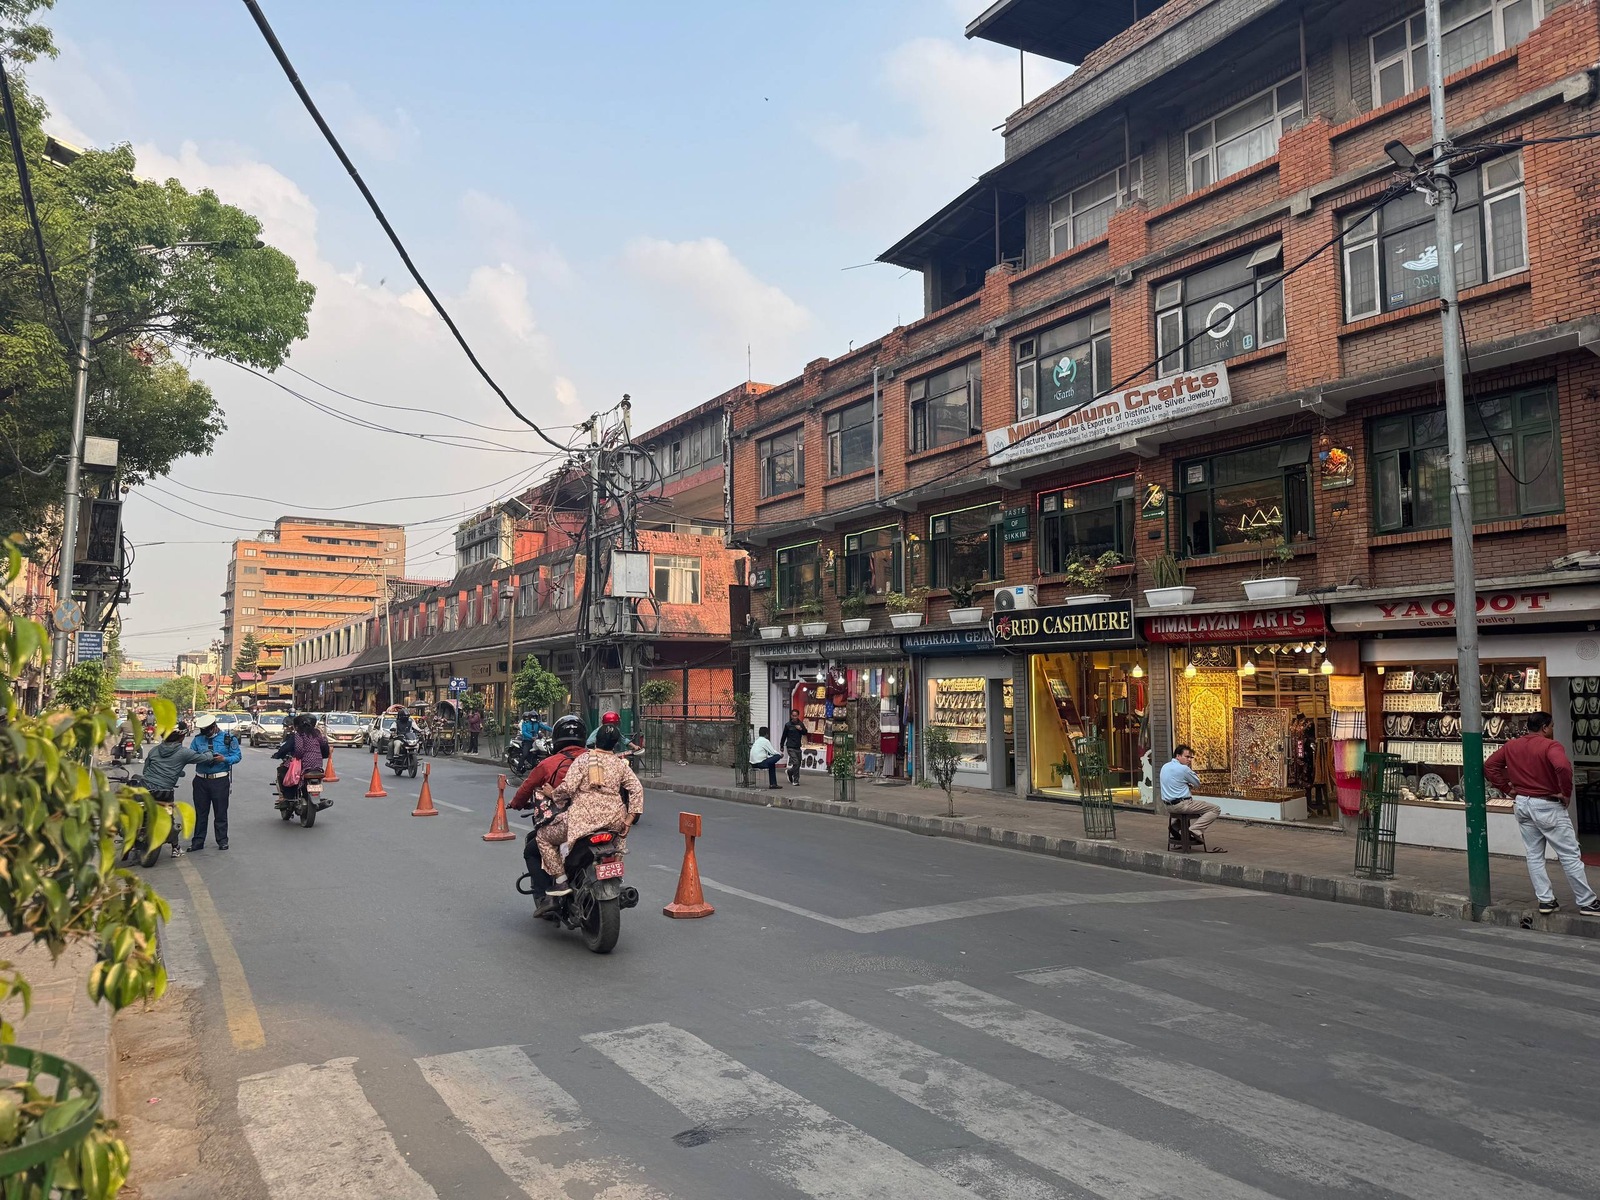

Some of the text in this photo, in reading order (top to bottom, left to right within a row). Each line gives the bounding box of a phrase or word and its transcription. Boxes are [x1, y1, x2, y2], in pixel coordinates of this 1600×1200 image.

[1007, 372, 1219, 444] Millennium Crafts
[1047, 426, 1079, 441] Wholesaler
[1080, 423, 1087, 432] &
[1087, 416, 1113, 431] Exporter
[1115, 413, 1122, 422] of
[1124, 403, 1162, 420] Distinctive
[1164, 396, 1185, 409] Silver
[1188, 388, 1216, 402] Jewelry
[1005, 507, 1026, 516] TASTE
[1005, 531, 1027, 541] SIKKIM
[1011, 611, 1130, 636] RED CASHMERE
[1152, 609, 1306, 633] HIMALAYAN ARTS
[905, 633, 961, 646] MAHARAJA
[1195, 631, 1205, 639] OF
[1208, 629, 1267, 640] HANDICRAFTS
[760, 642, 813, 655] IMPERIAL GEMS
[825, 637, 896, 651] HAMRO HANDICRAFT
